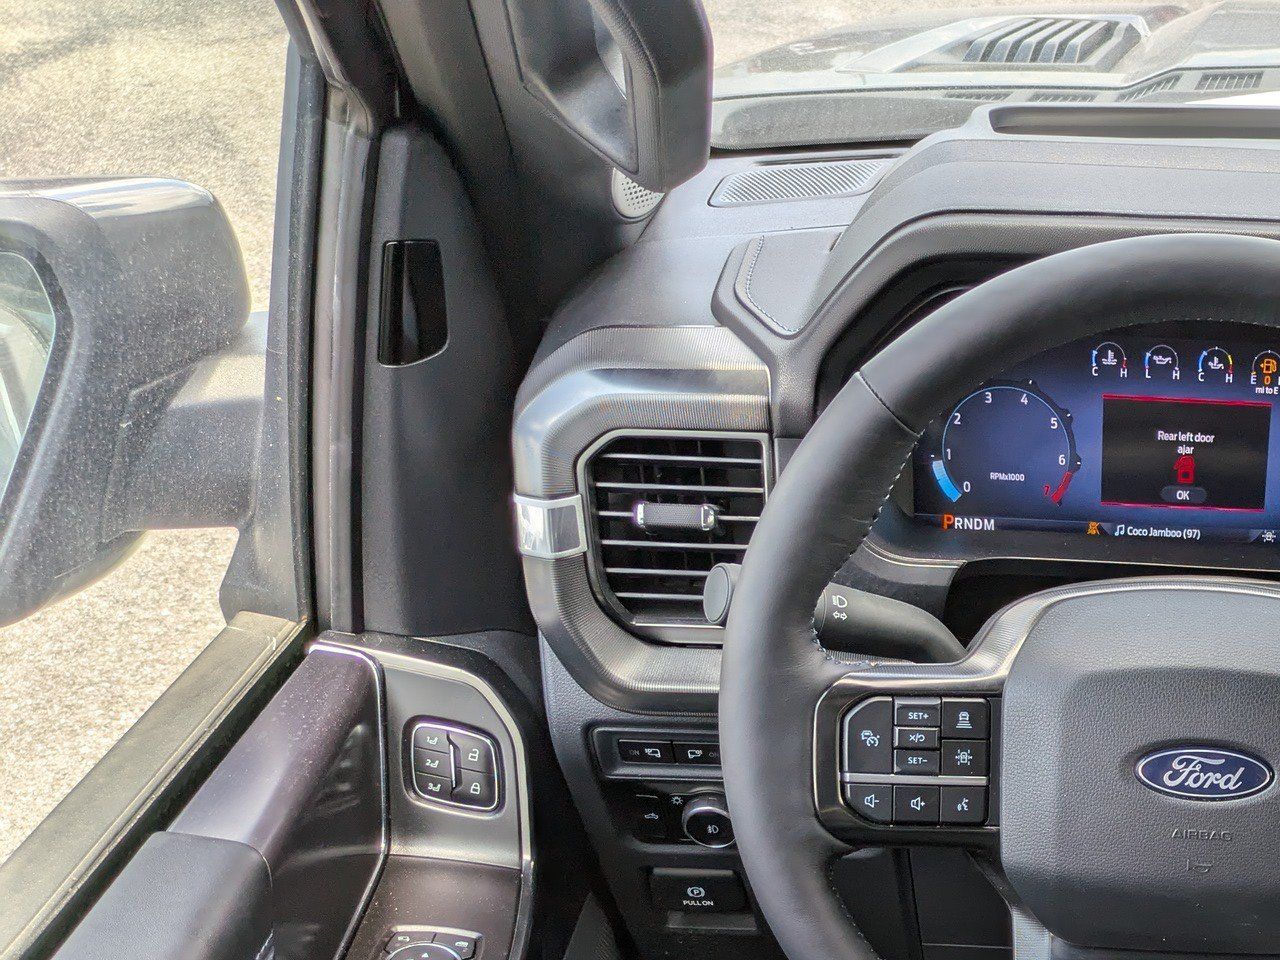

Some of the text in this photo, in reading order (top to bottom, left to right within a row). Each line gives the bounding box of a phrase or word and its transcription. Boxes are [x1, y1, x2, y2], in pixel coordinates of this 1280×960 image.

[985, 392, 992, 403] 3
[1020, 393, 1028, 405] 4
[954, 413, 961, 425] 2
[1050, 417, 1058, 429] 5
[1157, 430, 1215, 443] Rear left door
[946, 449, 951, 460] 1
[1177, 445, 1194, 455] ajar
[1058, 454, 1066, 466] 6
[990, 472, 1025, 482] RPMx1000
[963, 481, 971, 493] 0
[1043, 484, 1050, 496] 7
[1176, 490, 1190, 501] OK
[1127, 527, 1201, 540] Coco Jamboo (97)
[1163, 755, 1245, 791] Ford
[1170, 828, 1234, 842] AIRBAG
